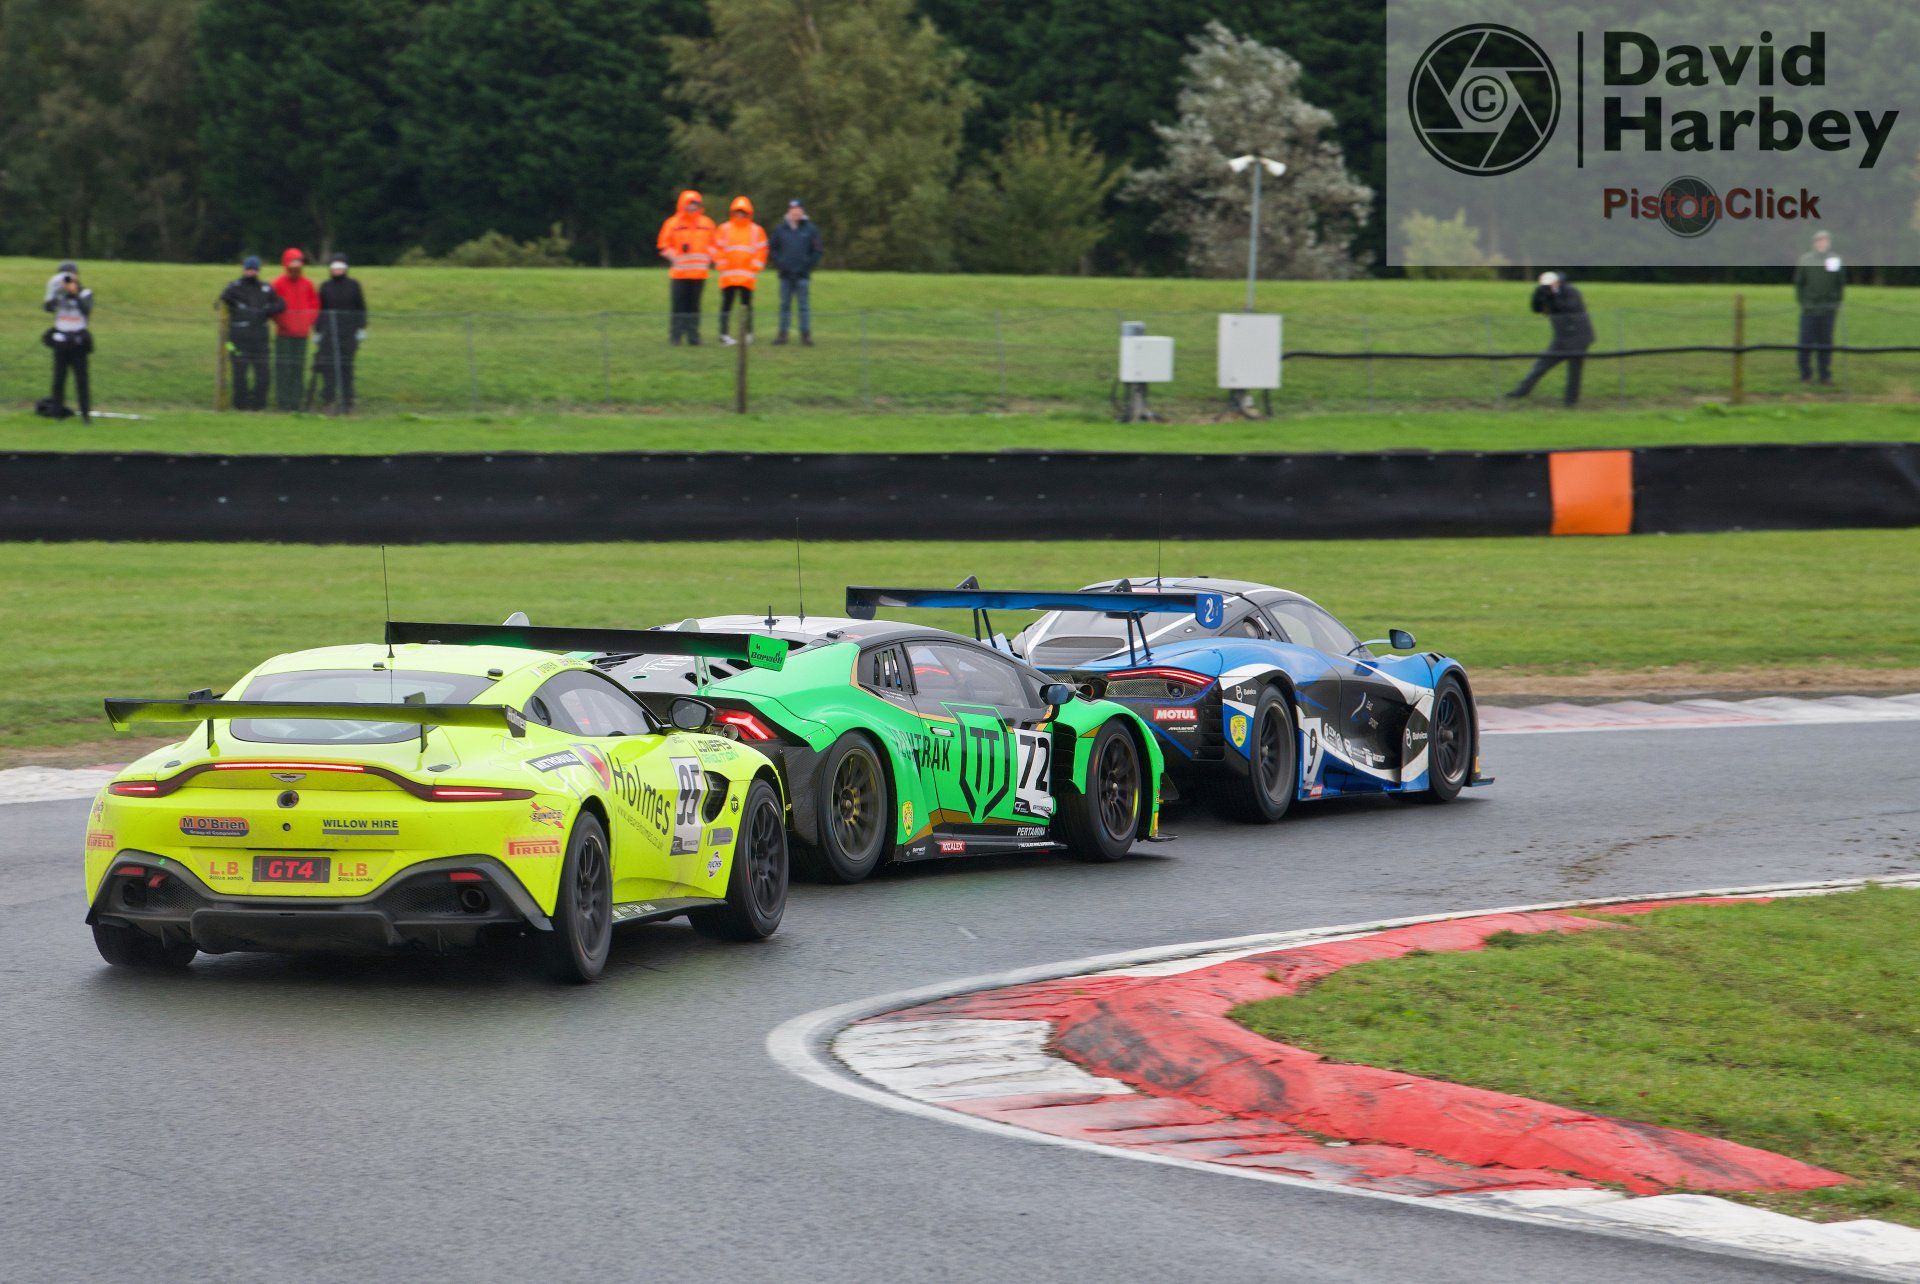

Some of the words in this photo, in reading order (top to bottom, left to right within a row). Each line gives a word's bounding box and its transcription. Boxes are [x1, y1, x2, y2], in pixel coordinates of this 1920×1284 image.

[1156, 709, 1196, 720] MOTUL
[1307, 728, 1317, 774] 9
[1019, 735, 1048, 793] 72
[606, 752, 671, 836] Holmes
[676, 764, 703, 826] 95
[183, 818, 193, 828] M
[198, 819, 245, 830] O'Brien
[323, 819, 367, 828] WILLOW
[372, 820, 398, 828] HIRE
[508, 840, 561, 856] PIRELLI
[268, 861, 315, 879] GT4
